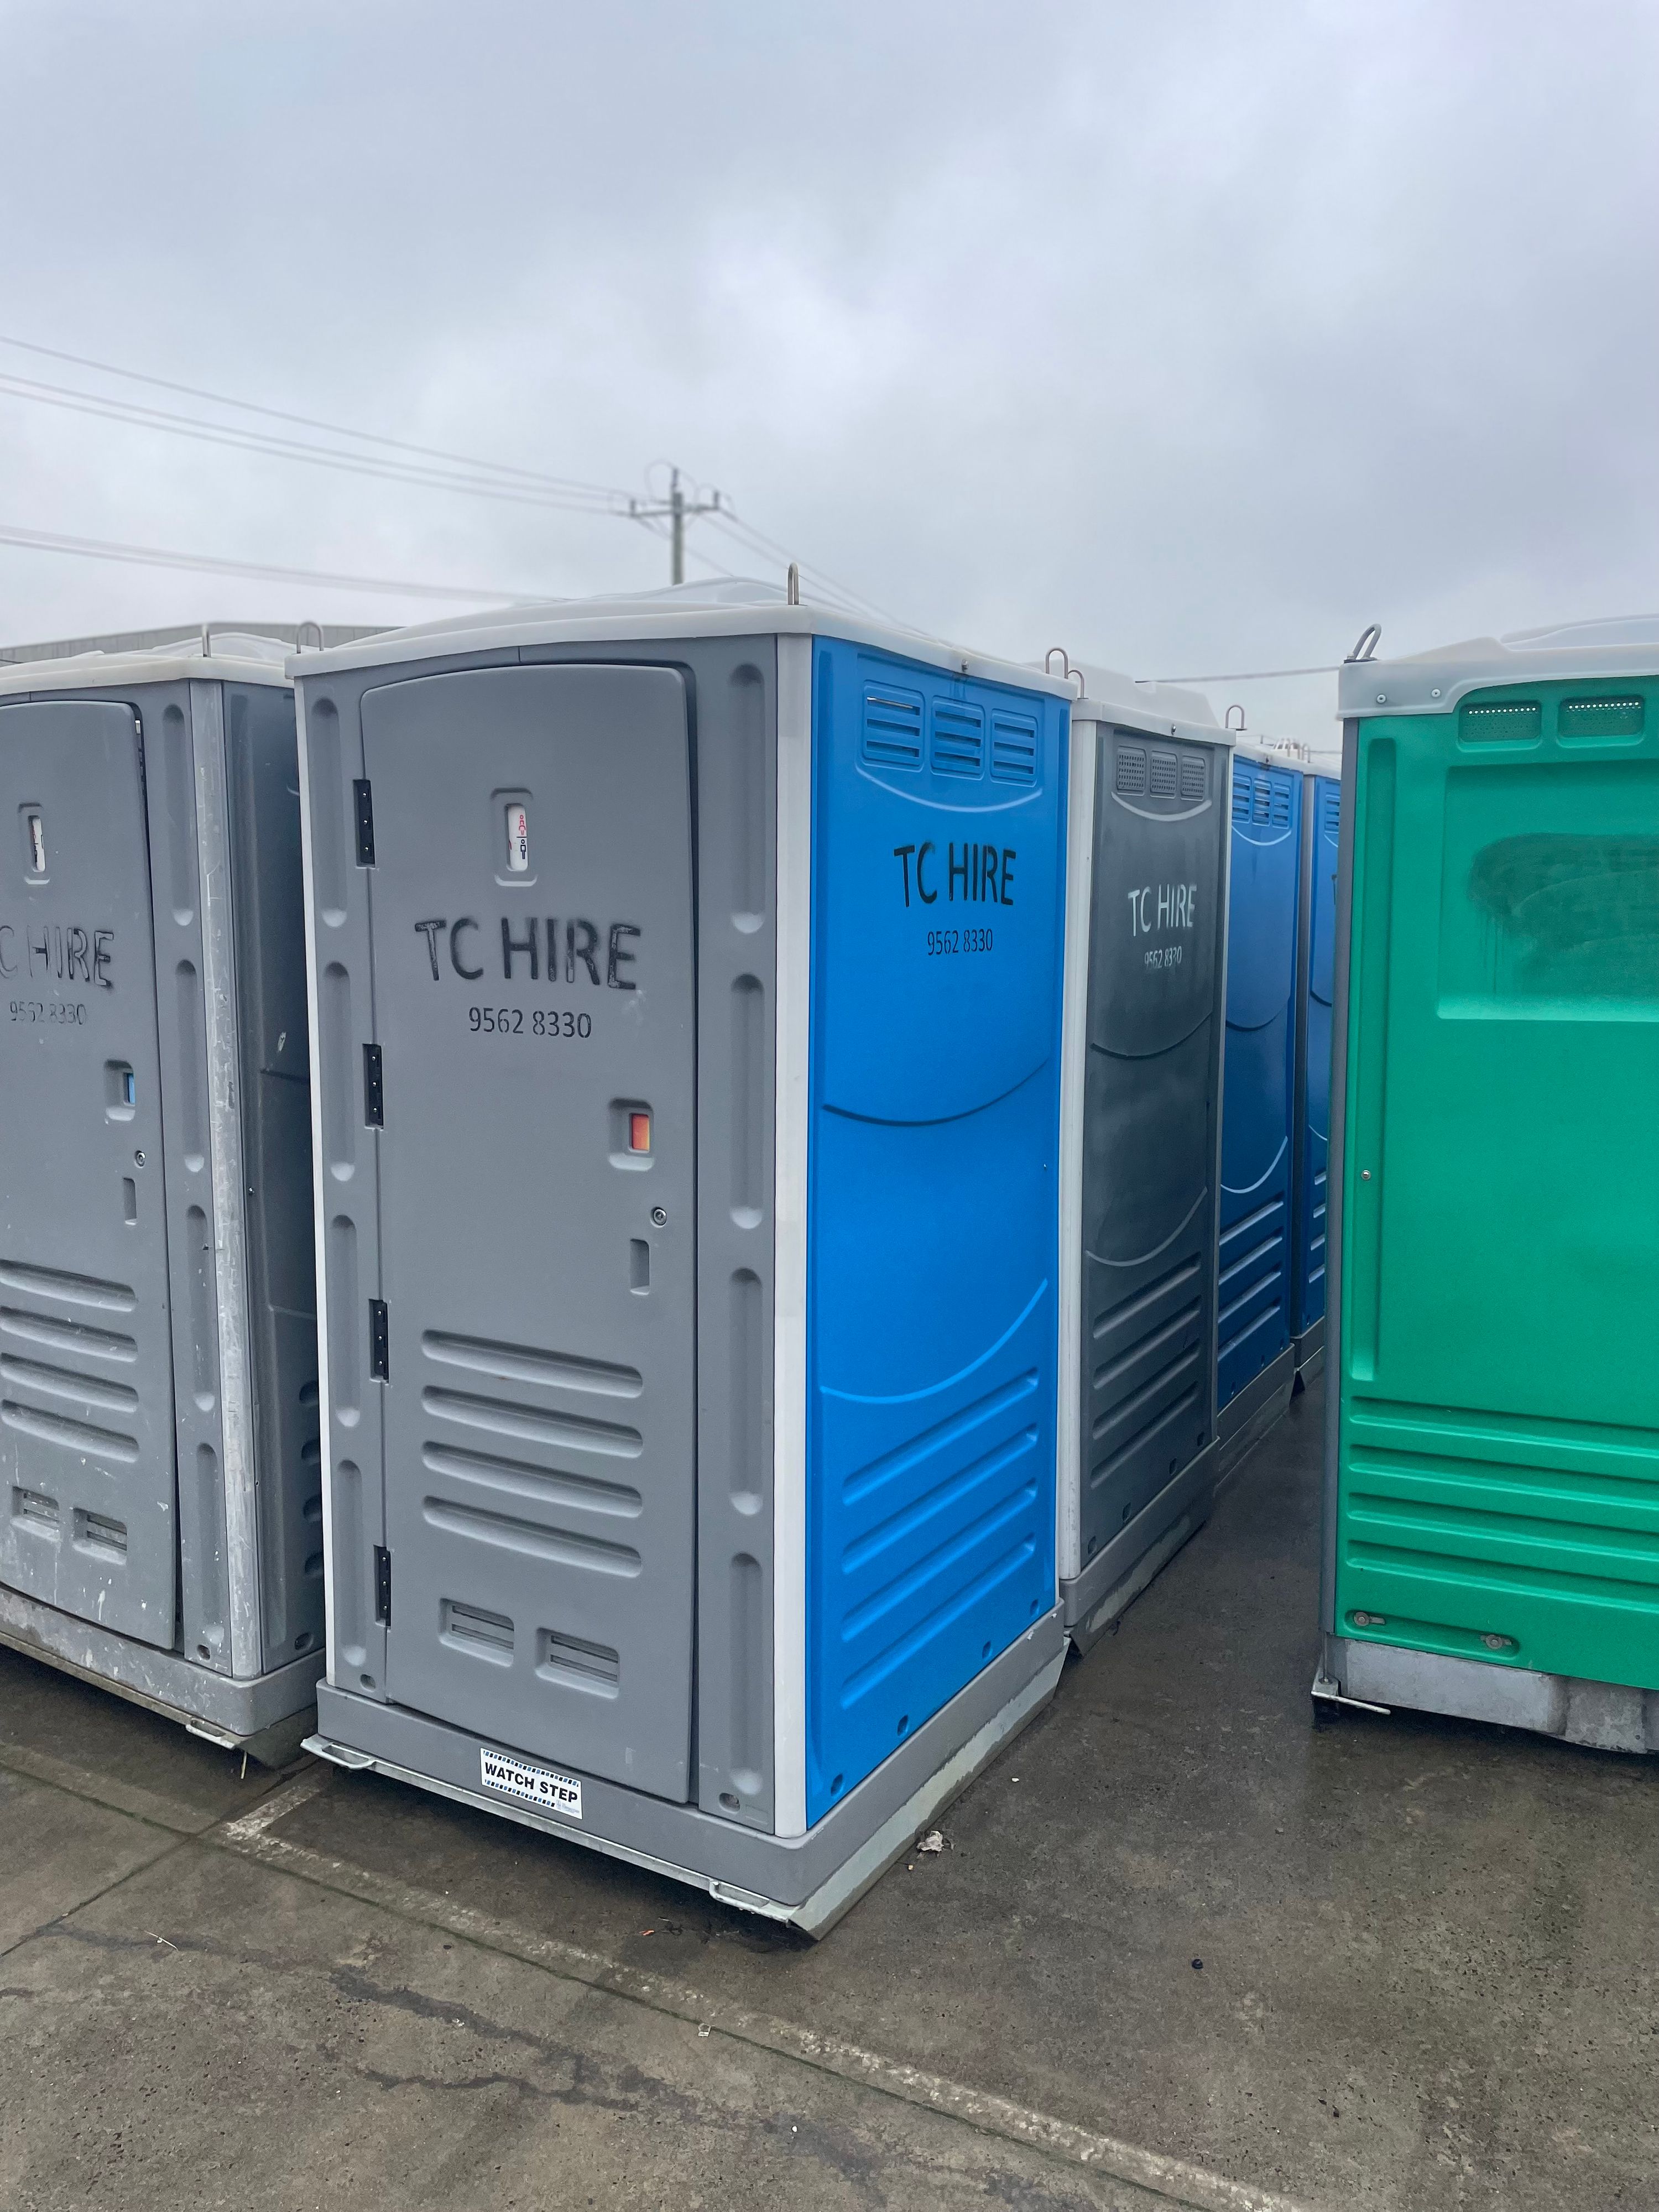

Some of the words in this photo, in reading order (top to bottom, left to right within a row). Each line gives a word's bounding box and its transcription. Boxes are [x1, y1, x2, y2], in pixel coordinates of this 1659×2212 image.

[894, 840, 937, 907] TC
[949, 842, 1016, 905] HIRE
[1128, 886, 1152, 937] TC
[1157, 883, 1197, 929] HIRE
[27, 924, 114, 989] HIRE
[415, 916, 484, 981] TC
[501, 916, 641, 990] HIRE
[927, 930, 959, 956] 9562
[963, 928, 993, 952] 8330
[1144, 948, 1162, 969] 9562
[469, 1006, 524, 1034] 9562
[533, 1010, 592, 1039] 8330
[484, 1761, 535, 1790] WATCH
[539, 1781, 578, 1803] STEP
